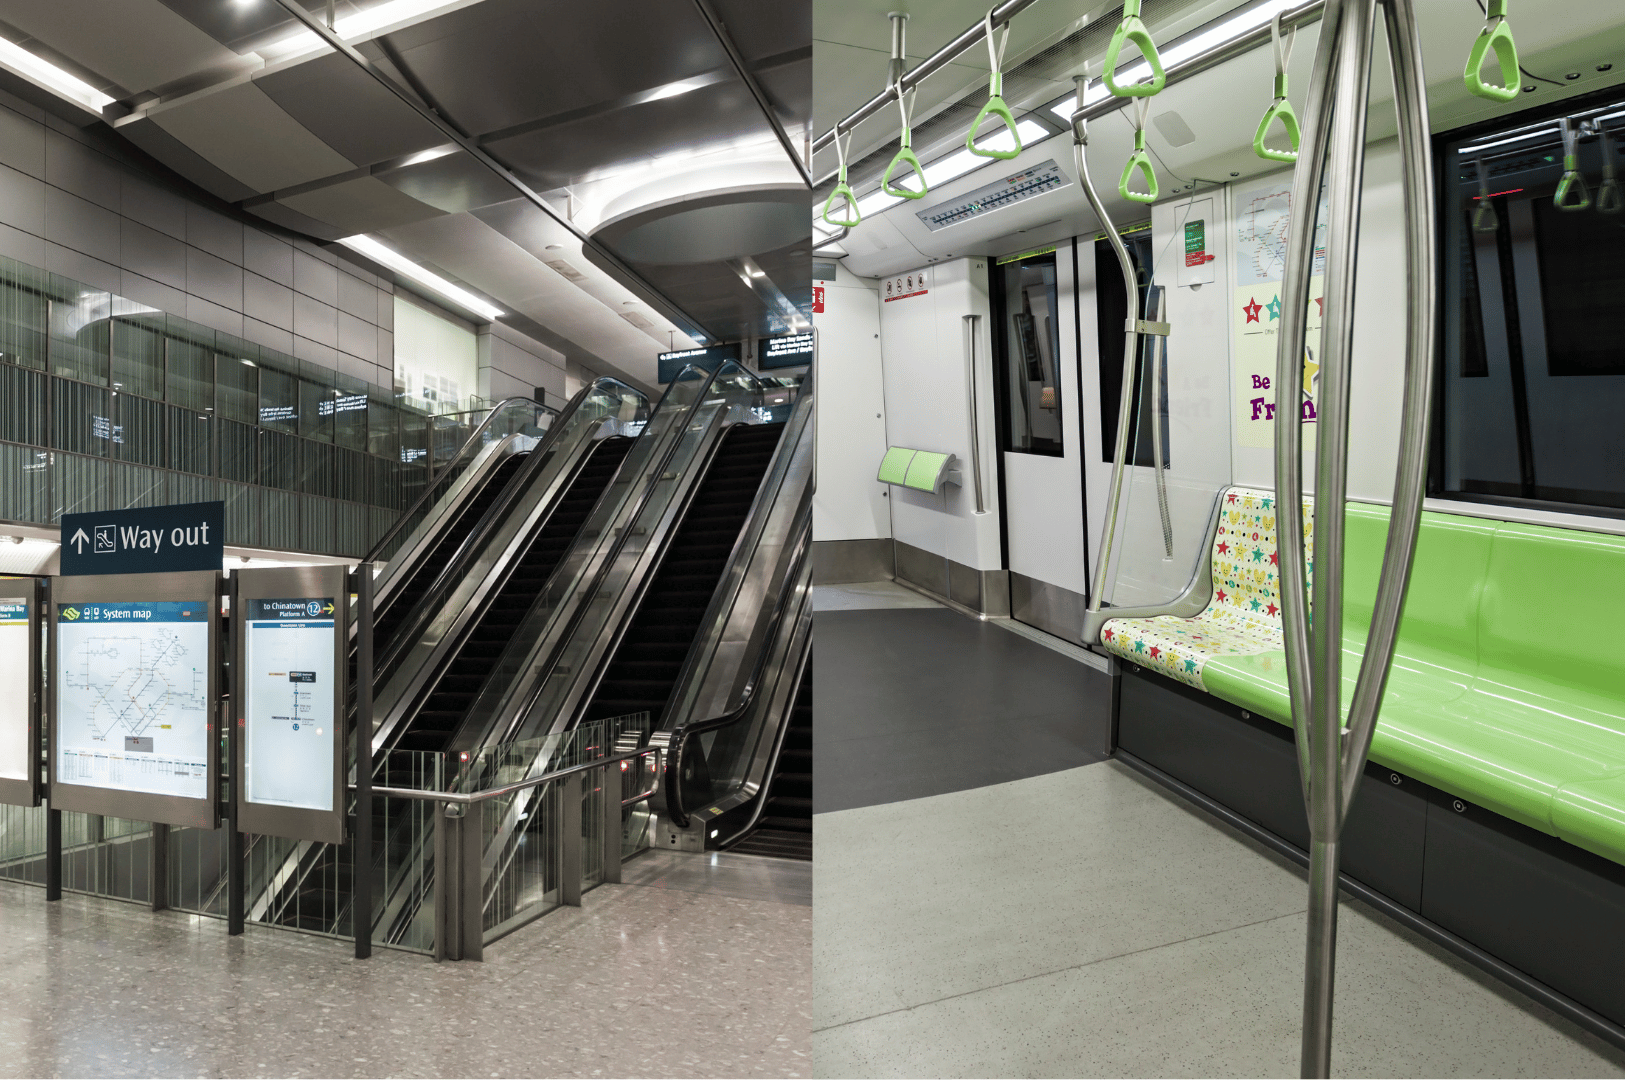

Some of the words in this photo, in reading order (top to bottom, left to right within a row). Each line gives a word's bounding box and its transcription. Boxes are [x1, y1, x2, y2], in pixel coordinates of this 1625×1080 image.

[1251, 374, 1270, 389] Be
[120, 525, 164, 554] Way
[171, 521, 209, 547] out
[103, 608, 131, 620] System
[133, 609, 152, 620] map
[272, 602, 306, 610] Chinatown
[310, 604, 318, 613] 12
